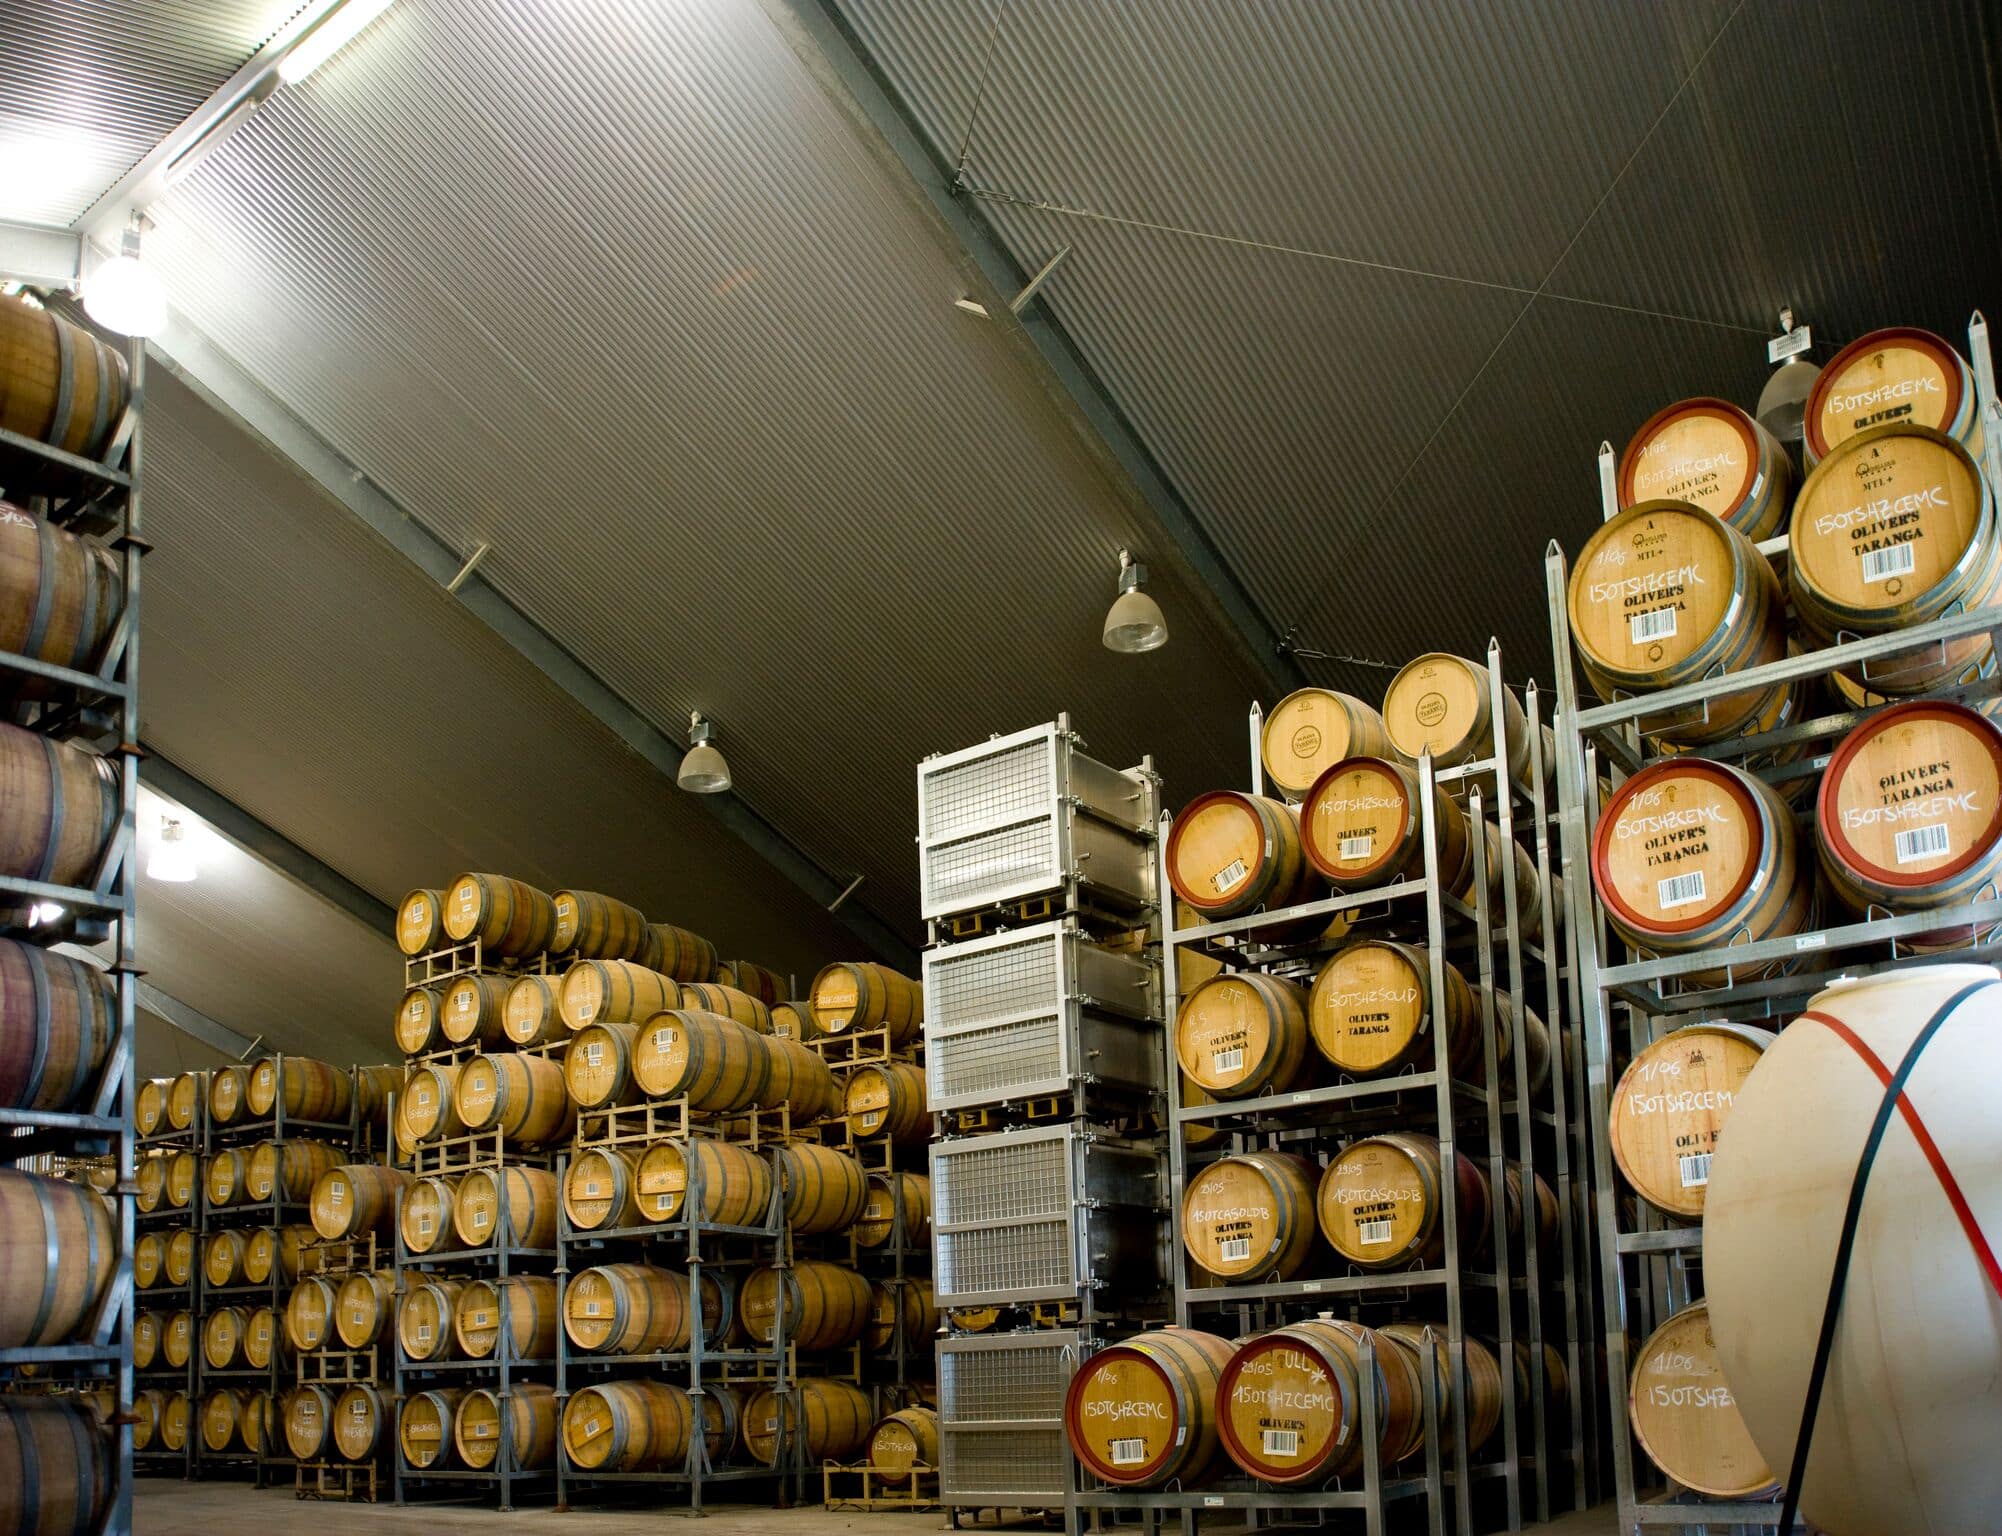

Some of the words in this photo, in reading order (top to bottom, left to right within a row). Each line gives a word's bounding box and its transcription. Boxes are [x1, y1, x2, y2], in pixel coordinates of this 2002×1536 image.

[1854, 403, 1912, 429] OLIVER'S
[1666, 472, 1718, 495] OLIVER'S
[1680, 484, 1720, 502] RANGA
[1851, 510, 1920, 540] OLIVER'S
[1852, 527, 1923, 556] TARANGA
[1624, 585, 1684, 607] OLIVER'S
[1880, 760, 1951, 791] OLIVER'S
[1881, 778, 1954, 805] TARANGA
[1645, 825, 1706, 850] OLIVER'S
[1646, 842, 1709, 867] TARANGA
[1349, 1013, 1390, 1023] OLIVER'S
[1349, 1025, 1390, 1035] TARANGA
[1210, 1030, 1247, 1046] OLIVER'S
[1630, 1091, 1738, 1116] 15OTSHZCEM
[1676, 1130, 1721, 1147] OLIVE
